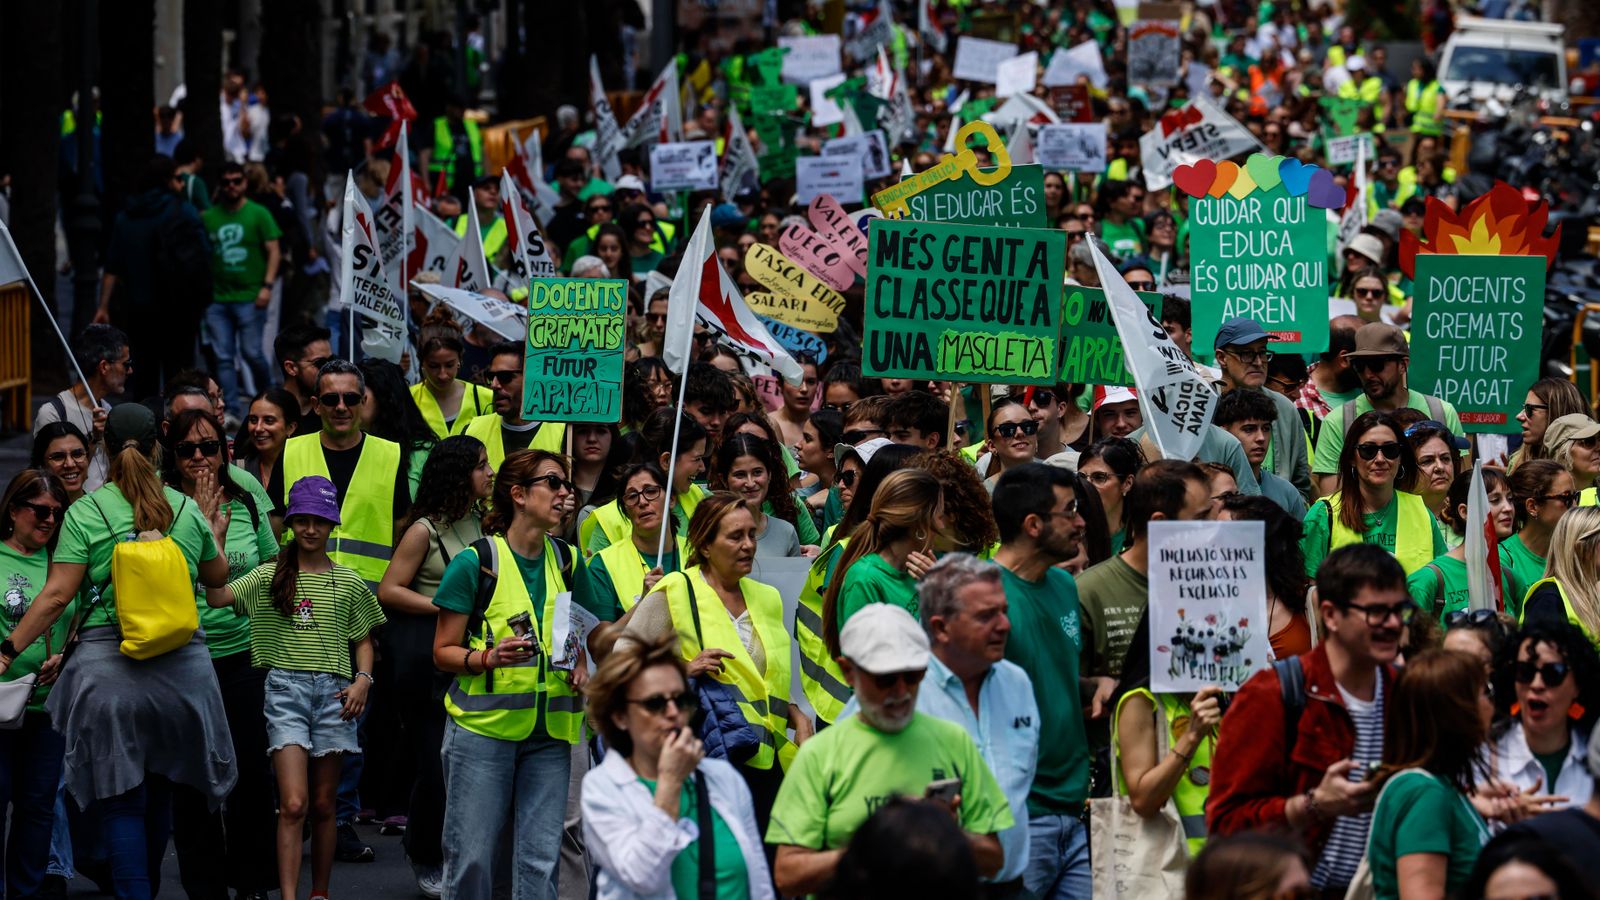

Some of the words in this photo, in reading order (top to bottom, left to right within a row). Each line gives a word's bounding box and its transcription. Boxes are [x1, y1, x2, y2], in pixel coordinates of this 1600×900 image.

[911, 195, 928, 221] SI
[935, 190, 1003, 221] EDUCAR
[1011, 181, 1037, 215] ÉS
[1195, 197, 1262, 225] CUIDAR
[1273, 197, 1305, 224] QUI
[788, 224, 841, 267] UECO
[815, 196, 868, 266] VALENC
[1219, 230, 1294, 258] EDUCA
[754, 245, 805, 288] TASCA
[876, 228, 937, 271] MÉS
[942, 234, 1025, 277] GENT
[1025, 241, 1050, 280] A
[1195, 259, 1219, 293] ÉS
[1225, 262, 1287, 290] CUIDAR
[1291, 261, 1322, 288] QUI
[1428, 276, 1526, 304] DOCENTS
[531, 281, 624, 312] DOCENTS
[752, 294, 807, 312] SALARI
[873, 274, 977, 322] CLASSE
[980, 279, 1029, 326] QUE
[1030, 283, 1051, 328] A
[1221, 292, 1296, 324] APRÈN
[529, 317, 623, 350] CREMATS
[1426, 312, 1524, 341] CREMATS
[869, 330, 934, 372] UNA
[1438, 346, 1508, 373] FUTUR
[543, 355, 597, 380] FUTUR
[525, 380, 621, 416] APAGAT
[1432, 378, 1514, 406] APAGAT
[1160, 545, 1217, 563] INCLUSIÓ
[1220, 547, 1256, 562] SENSE
[1170, 565, 1229, 581] RECURSOS
[1179, 580, 1240, 599] EXCLUSIÓ
